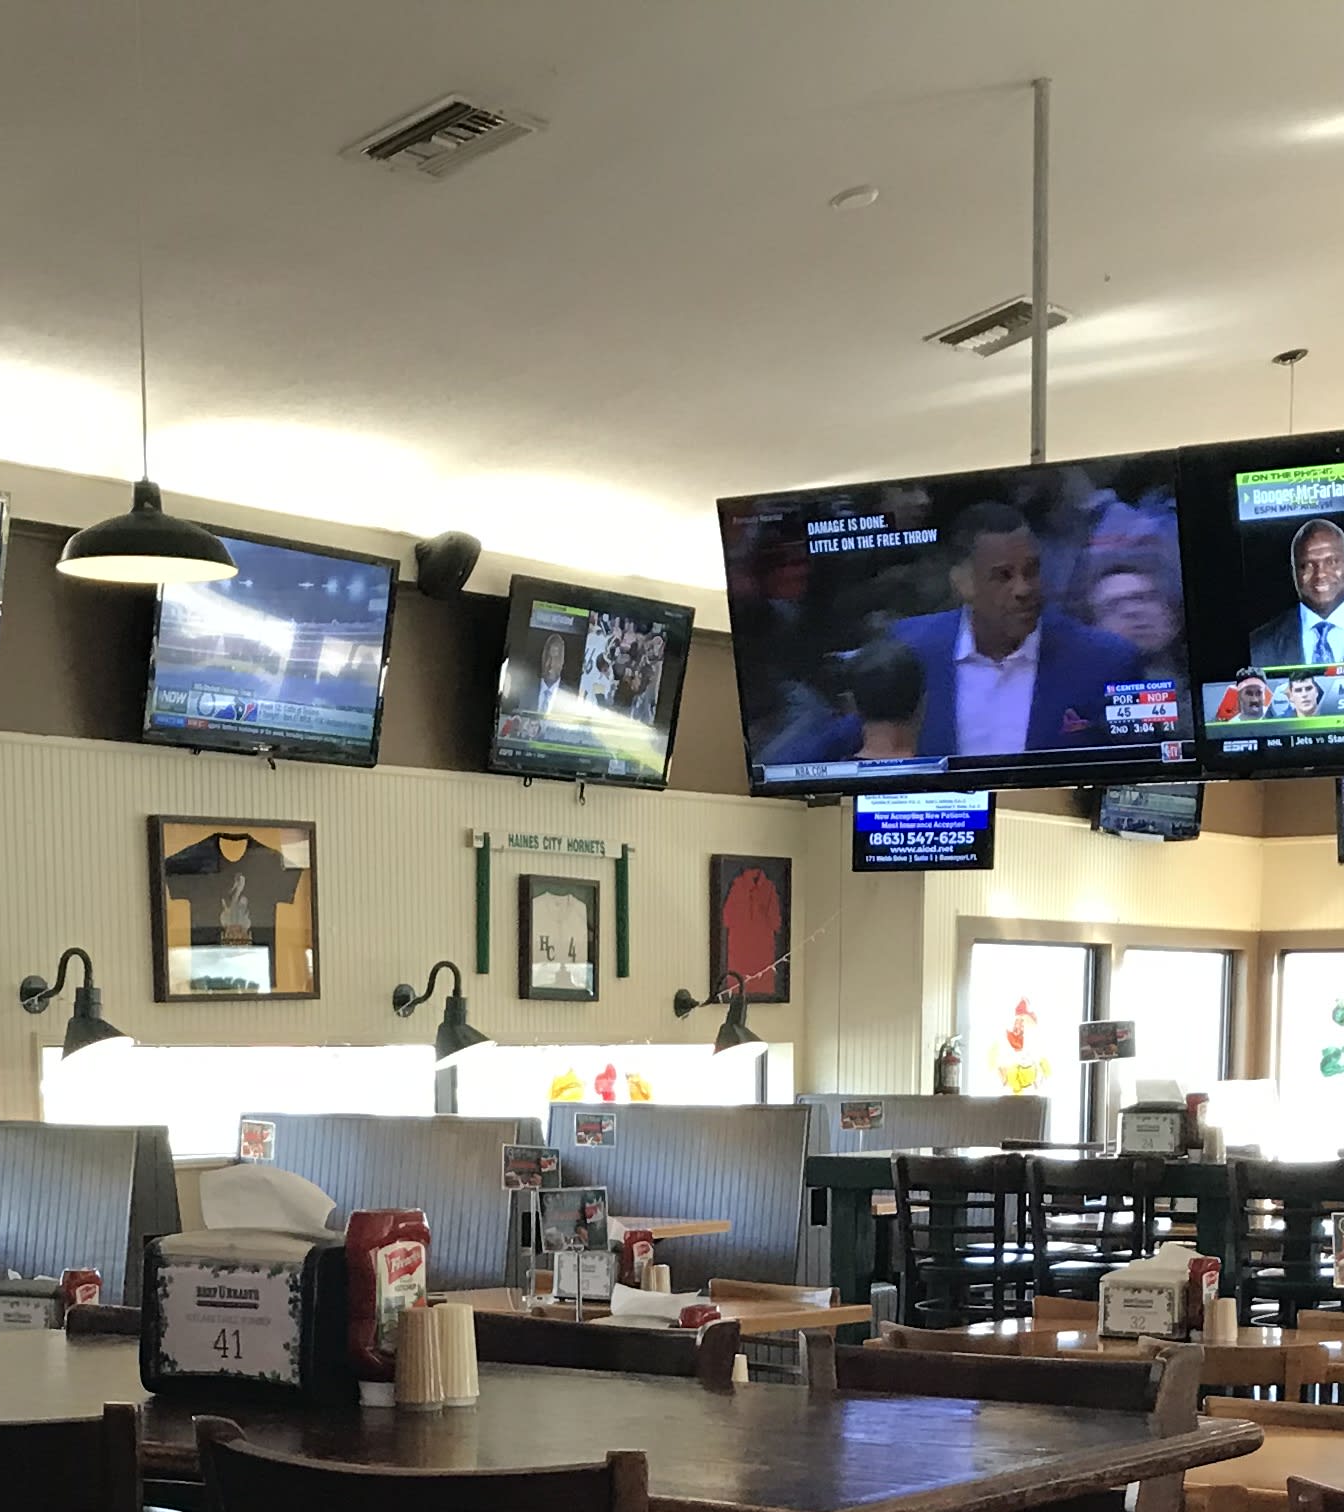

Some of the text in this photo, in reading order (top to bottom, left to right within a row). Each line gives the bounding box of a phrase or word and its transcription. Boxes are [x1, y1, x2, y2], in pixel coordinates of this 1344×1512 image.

[1251, 474, 1268, 482] ON
[1271, 472, 1291, 480] THE
[1254, 505, 1277, 515] ESPN
[808, 514, 889, 536] DAMAGE IS DONE.
[809, 528, 938, 554] LITTLE ON THE FREE THROW
[1116, 683, 1145, 692] CENTER
[1112, 692, 1169, 705] POR NOP
[1117, 704, 1167, 718] 45 46
[1109, 724, 1129, 735] 2ND
[1133, 723, 1155, 733] 3:04
[1223, 739, 1259, 752] ESPN
[1295, 735, 1313, 746] Jets
[874, 811, 940, 822] Now Accepting New
[881, 820, 966, 830] Most Insurance Accepted
[508, 833, 606, 855] HAINES CITY HORNETS
[869, 830, 976, 846] (863) 547-6255
[568, 936, 577, 963] 4
[1130, 1315, 1146, 1330] 32
[213, 1327, 243, 1360] 41
